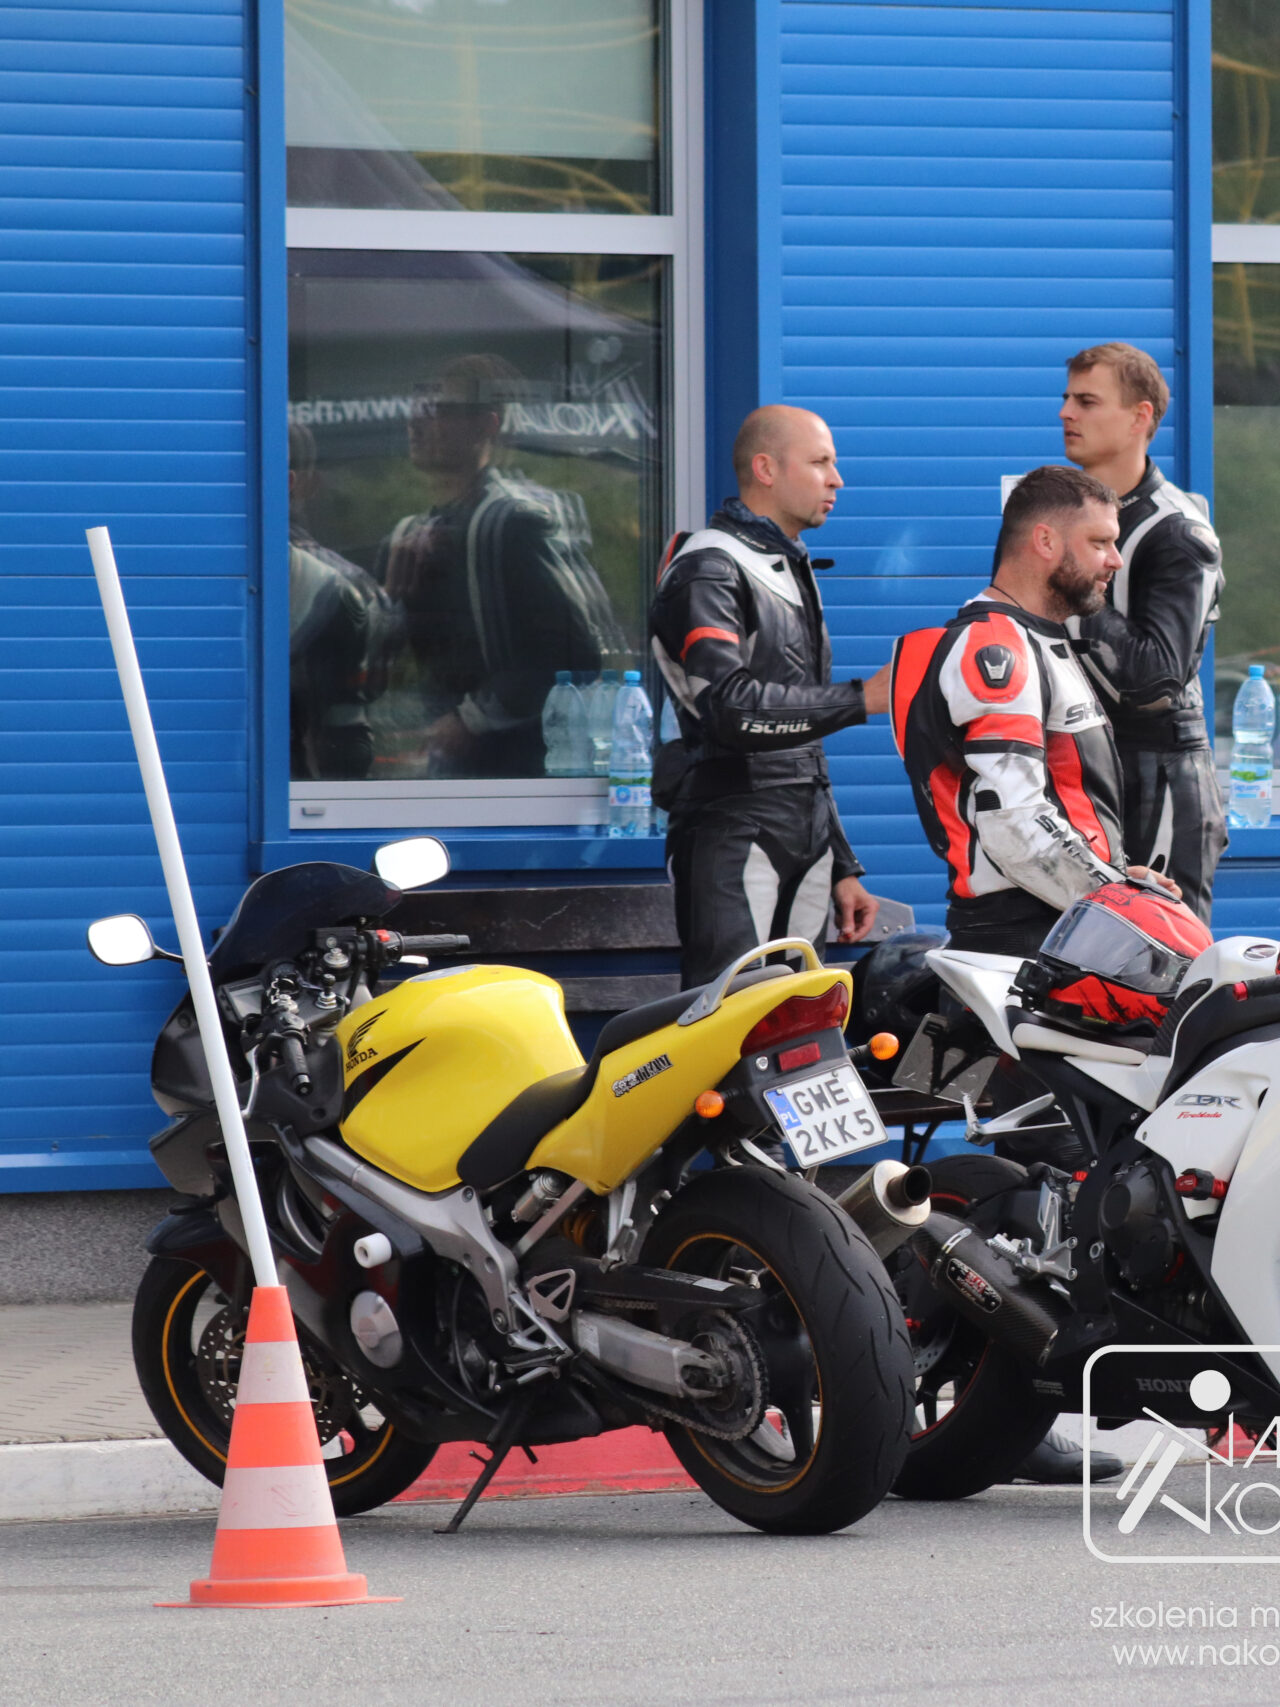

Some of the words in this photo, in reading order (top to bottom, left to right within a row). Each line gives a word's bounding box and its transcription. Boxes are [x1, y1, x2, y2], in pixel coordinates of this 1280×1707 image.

[345, 1047, 379, 1073] HONDA
[792, 1078, 850, 1117] GWE
[780, 1112, 799, 1127] PL
[795, 1108, 876, 1158] 2KK5
[1135, 1377, 1192, 1393] HON
